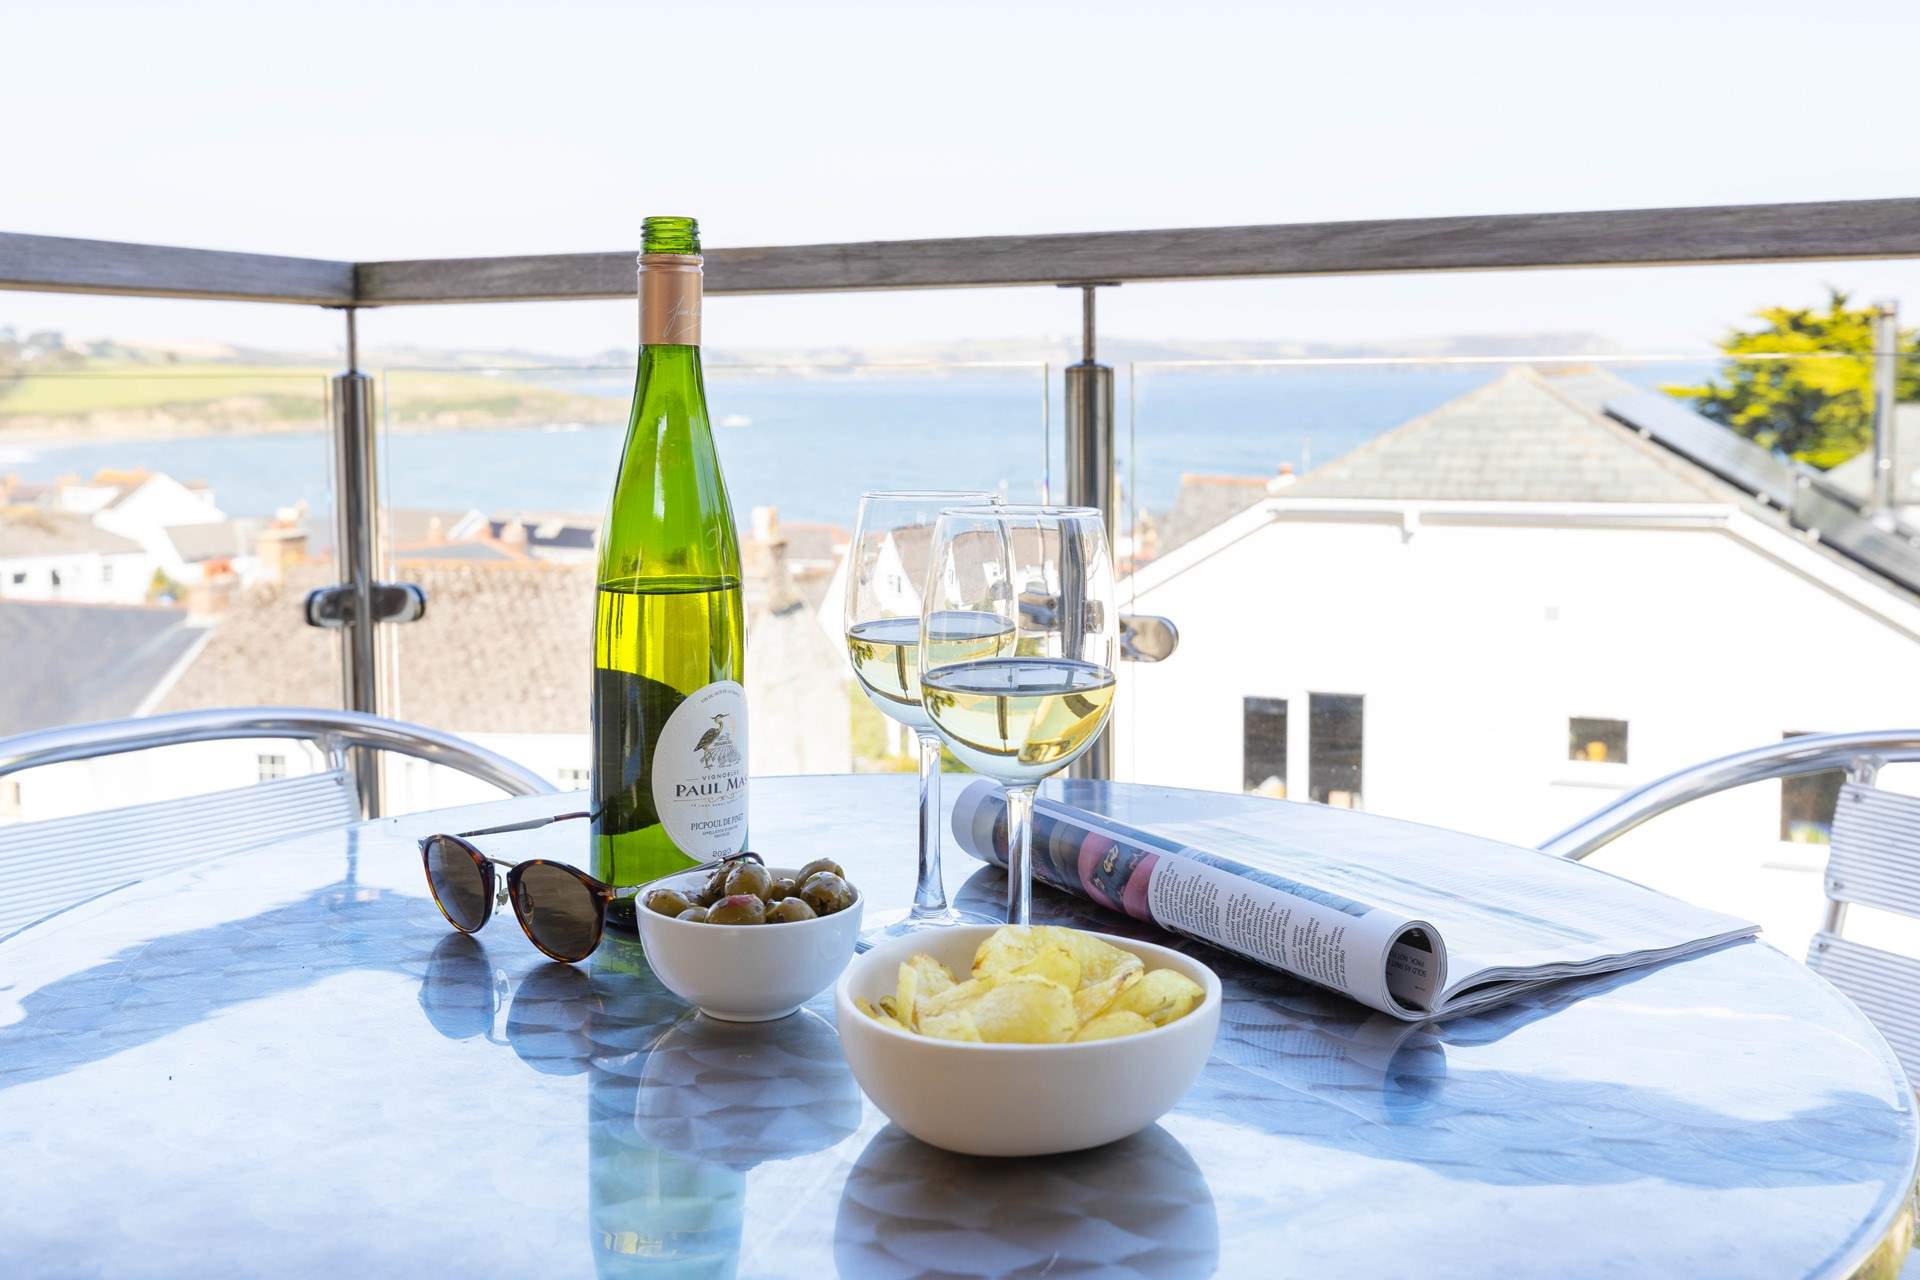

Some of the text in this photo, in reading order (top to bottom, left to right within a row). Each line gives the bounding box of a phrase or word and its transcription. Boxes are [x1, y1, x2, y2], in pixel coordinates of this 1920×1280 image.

[676, 783, 721, 797] PAUL
[690, 819, 722, 831] PICPOUL
[723, 817, 731, 826] DE
[1311, 921, 1320, 953] distinctive
